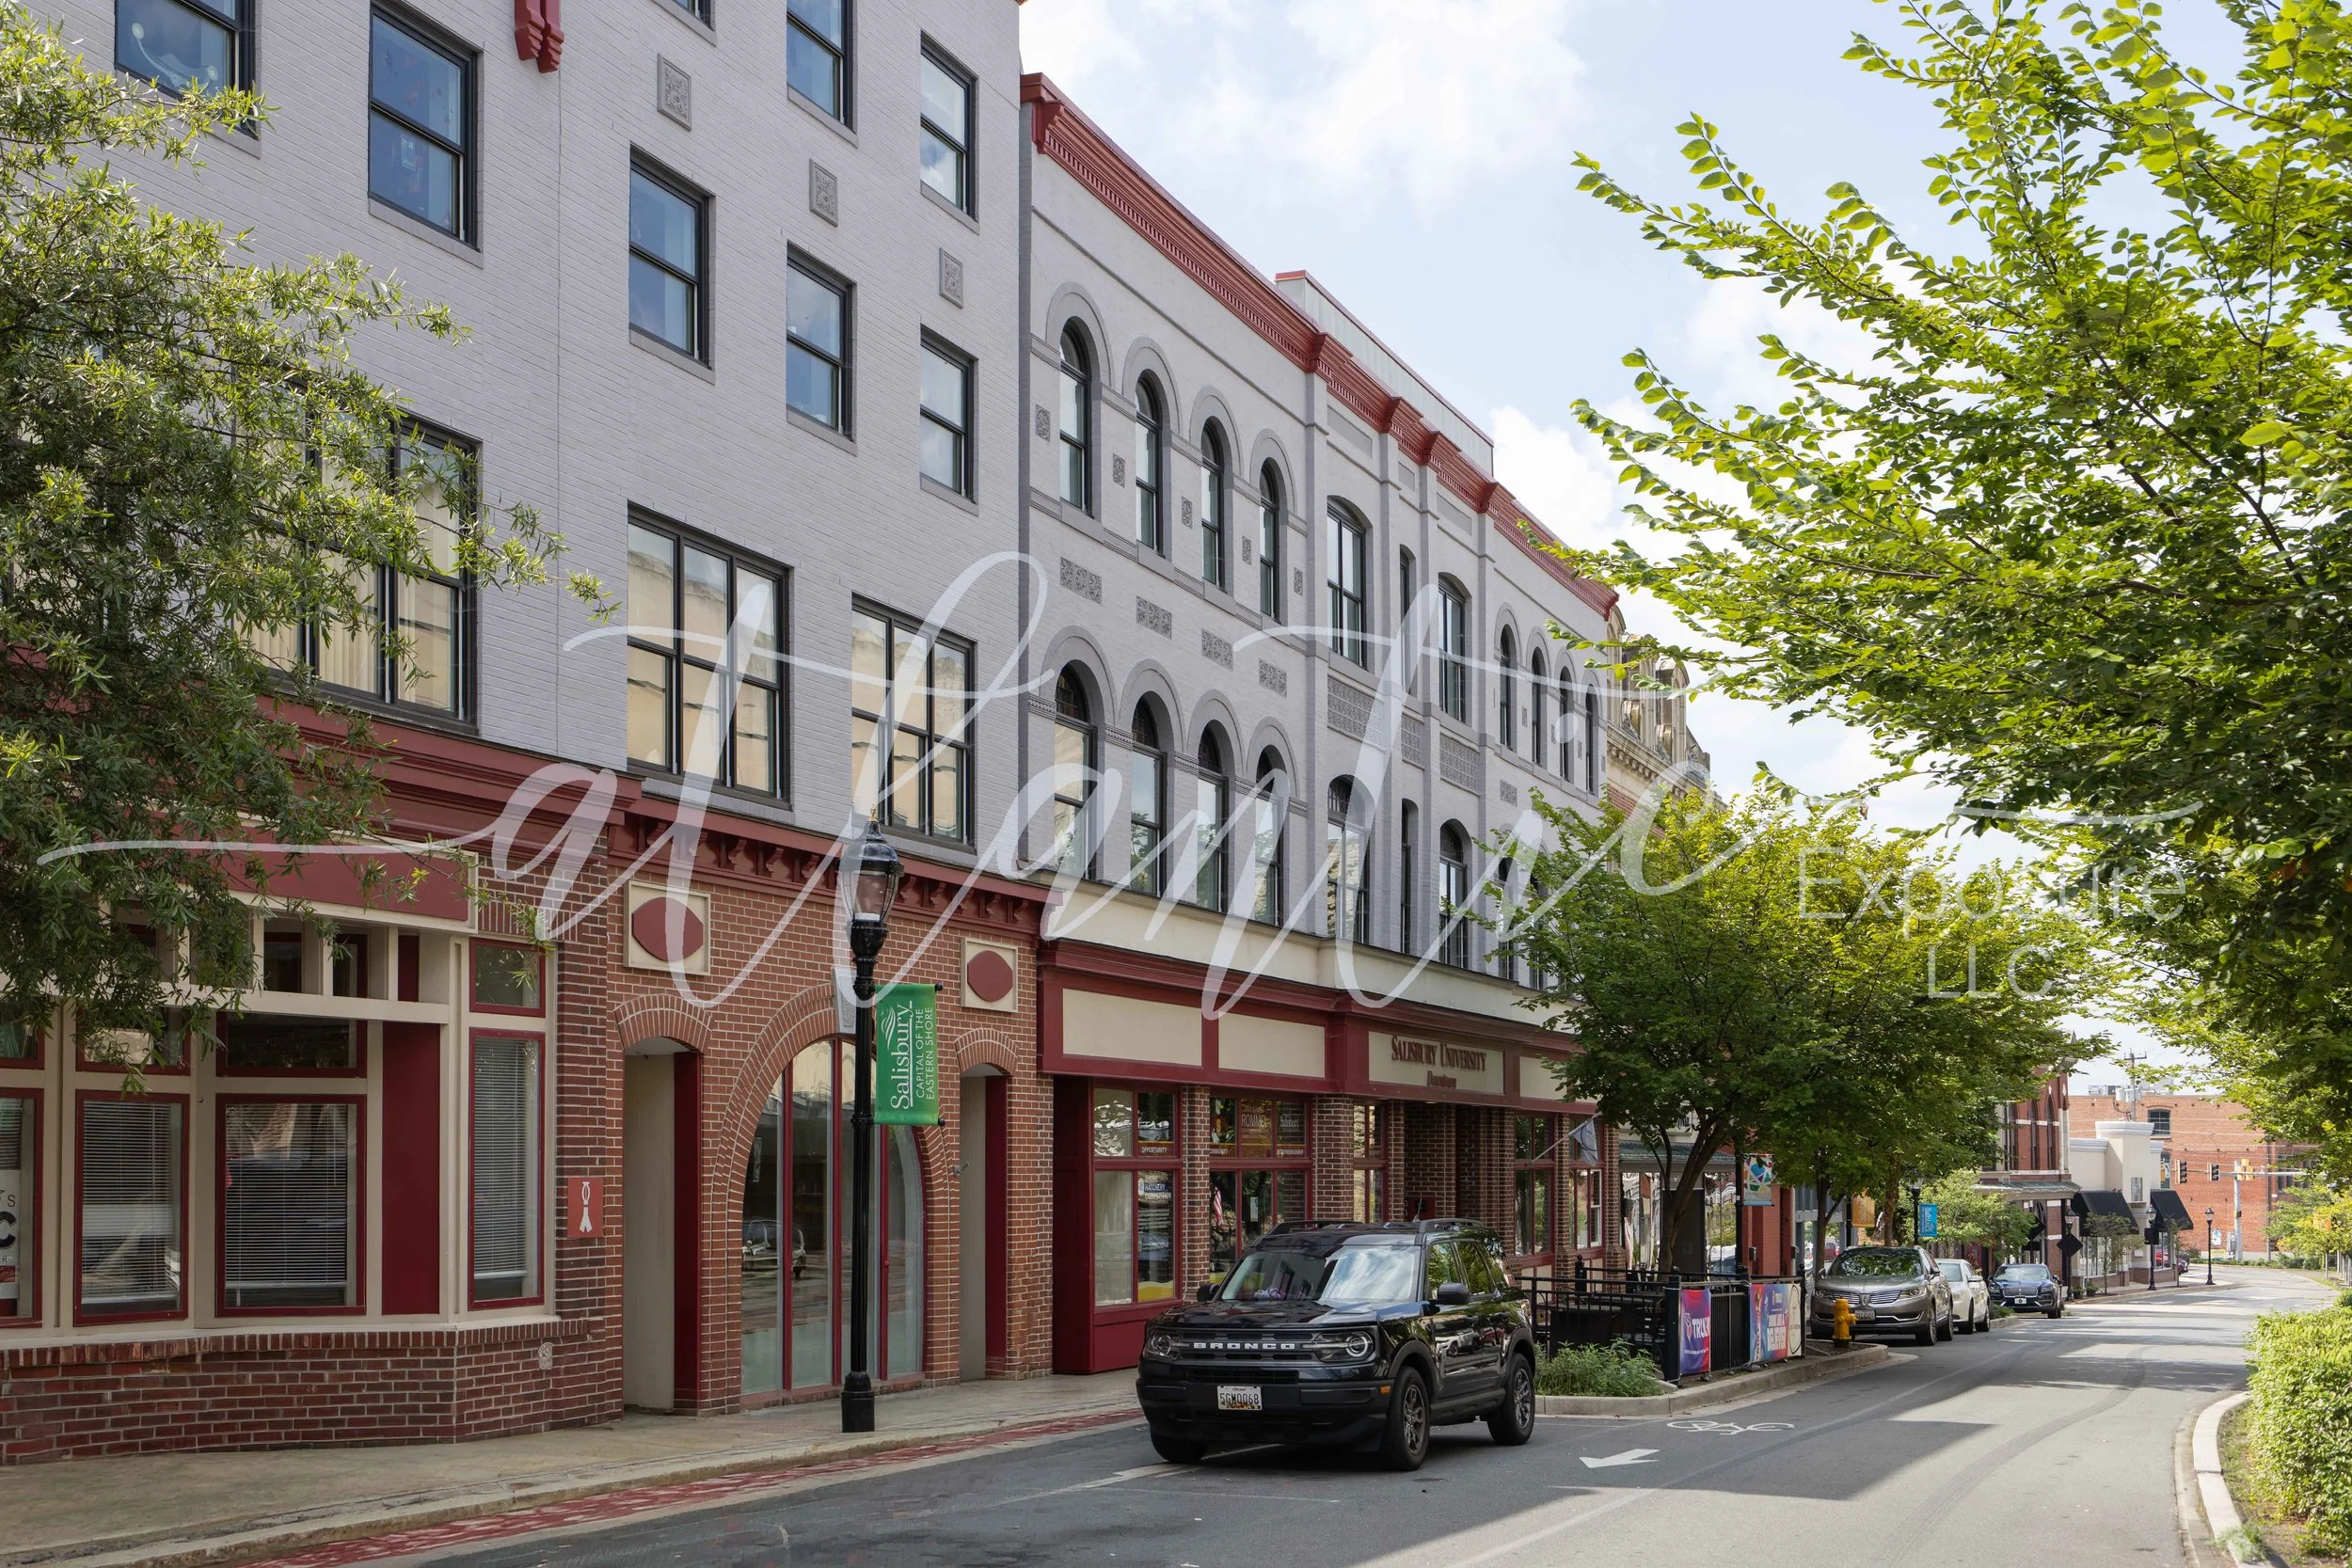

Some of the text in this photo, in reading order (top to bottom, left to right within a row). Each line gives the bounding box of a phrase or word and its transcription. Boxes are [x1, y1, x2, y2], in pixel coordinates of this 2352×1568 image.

[890, 1003, 914, 1110] Salisbury
[914, 1008, 925, 1099] CAPITAL OF THE
[925, 1006, 935, 1100] EASTERN SHORE
[1219, 1392, 1260, 1405] 5GM0068
